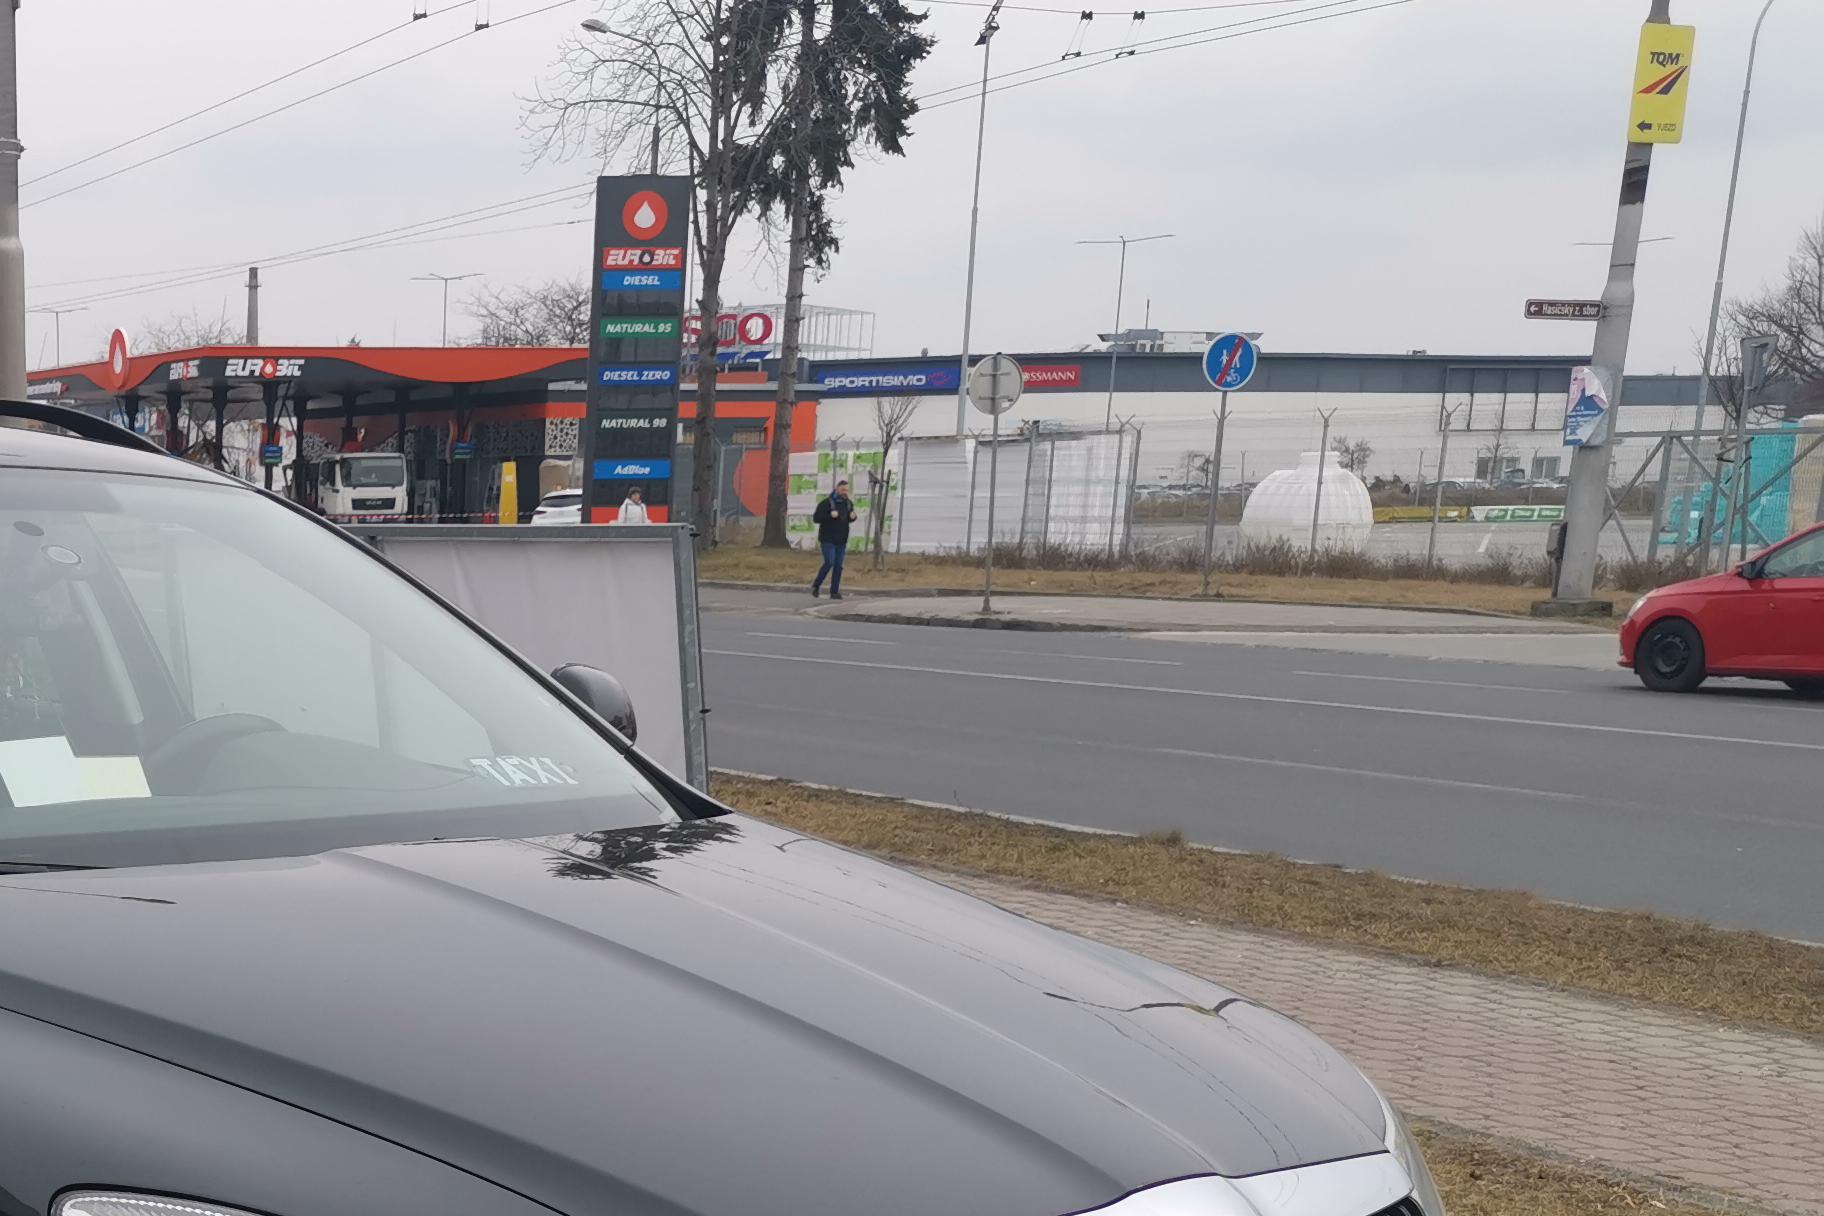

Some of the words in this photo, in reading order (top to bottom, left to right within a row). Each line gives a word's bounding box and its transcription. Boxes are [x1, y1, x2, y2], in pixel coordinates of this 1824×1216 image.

[1649, 51, 1681, 68] TQM
[623, 275, 660, 286] DIESEL
[1582, 304, 1599, 315] sbor
[606, 323, 656, 333] NATURAL
[657, 323, 672, 333] 95
[681, 313, 773, 349] SCO
[603, 370, 639, 381] DIESEL
[641, 370, 671, 381] ZERO
[824, 374, 926, 389] SPORTISIMO
[1023, 370, 1076, 382] OSSMANN
[601, 418, 650, 429] NATURAL
[652, 417, 668, 428] 98
[614, 465, 651, 475] AdBlue
[469, 755, 579, 785] TAXI
